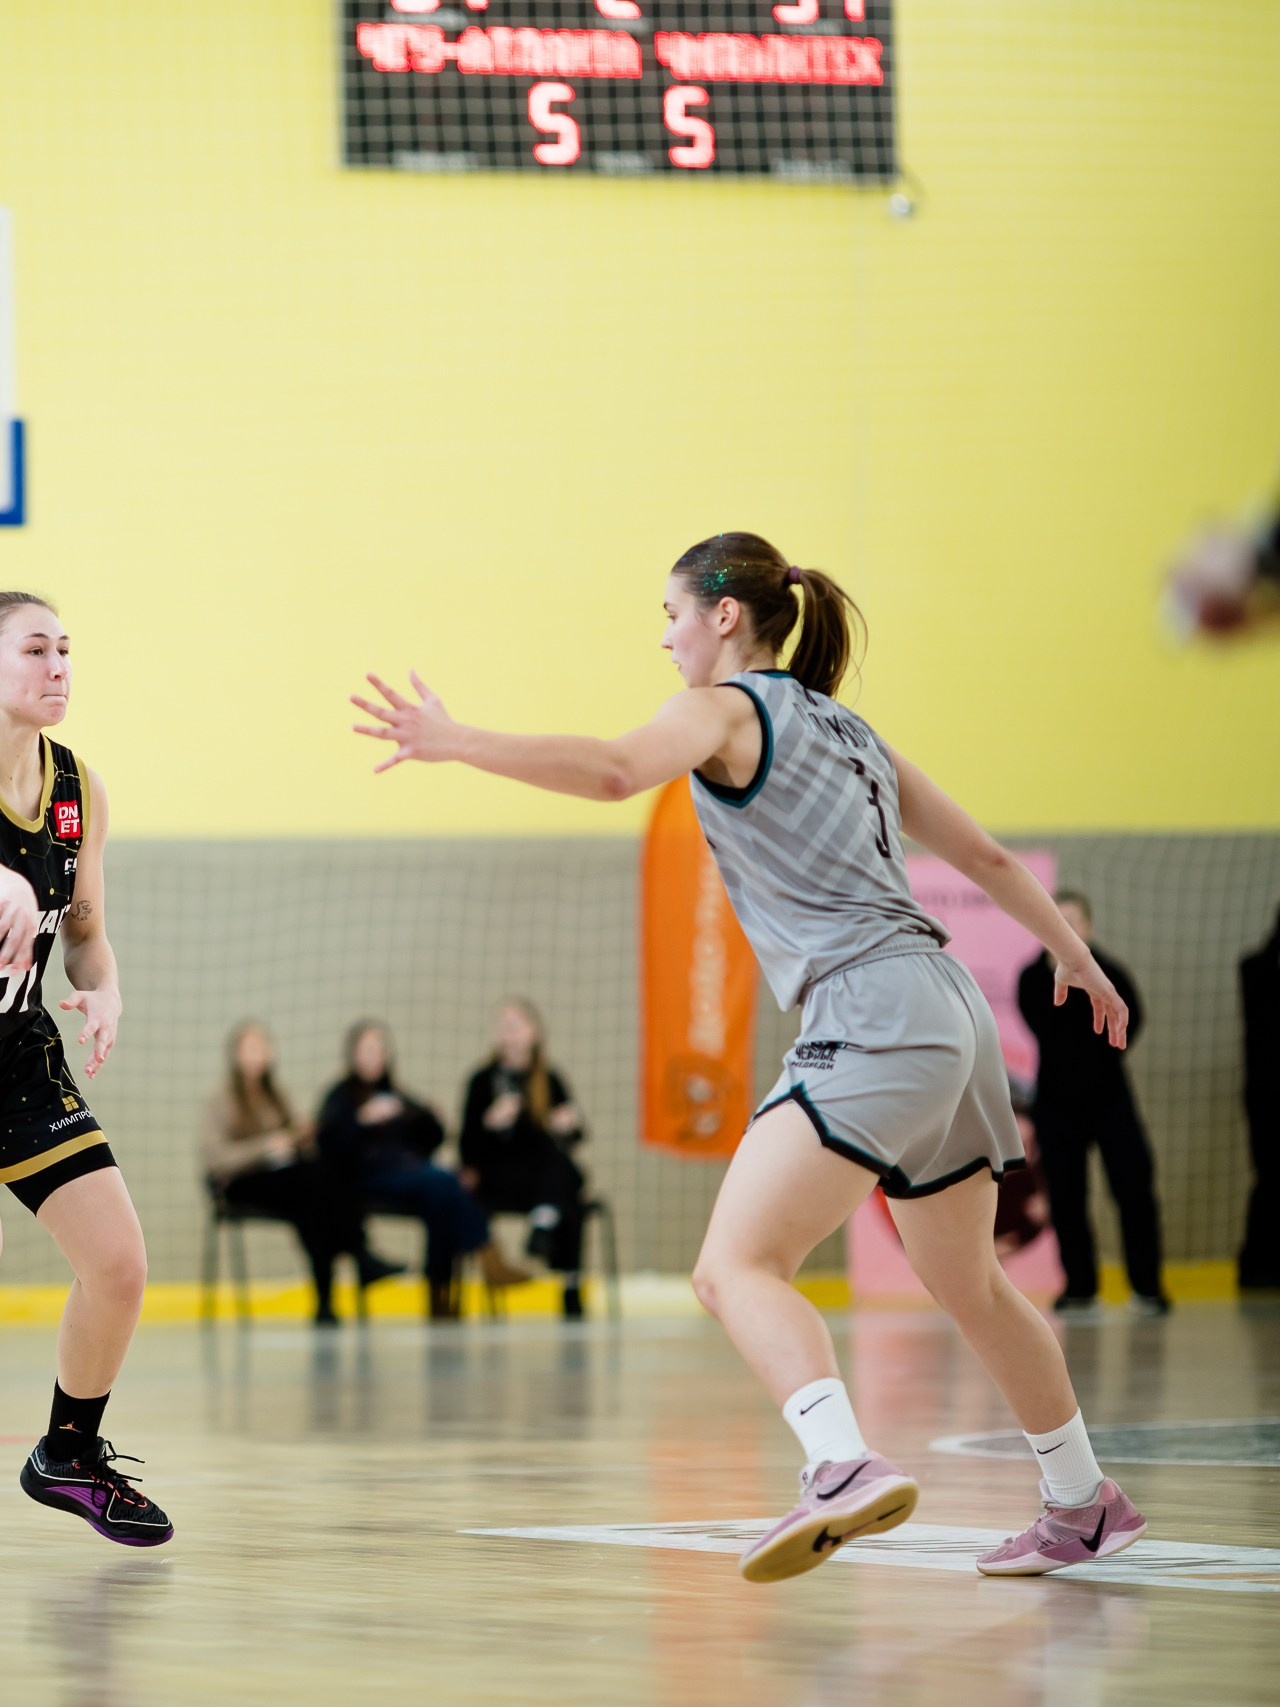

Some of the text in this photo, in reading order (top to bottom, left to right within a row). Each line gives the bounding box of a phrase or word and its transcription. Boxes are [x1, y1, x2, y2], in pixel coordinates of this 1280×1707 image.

[528, 82, 715, 167] 5 5
[58, 804, 79, 820] DN
[60, 818, 80, 834] ET
